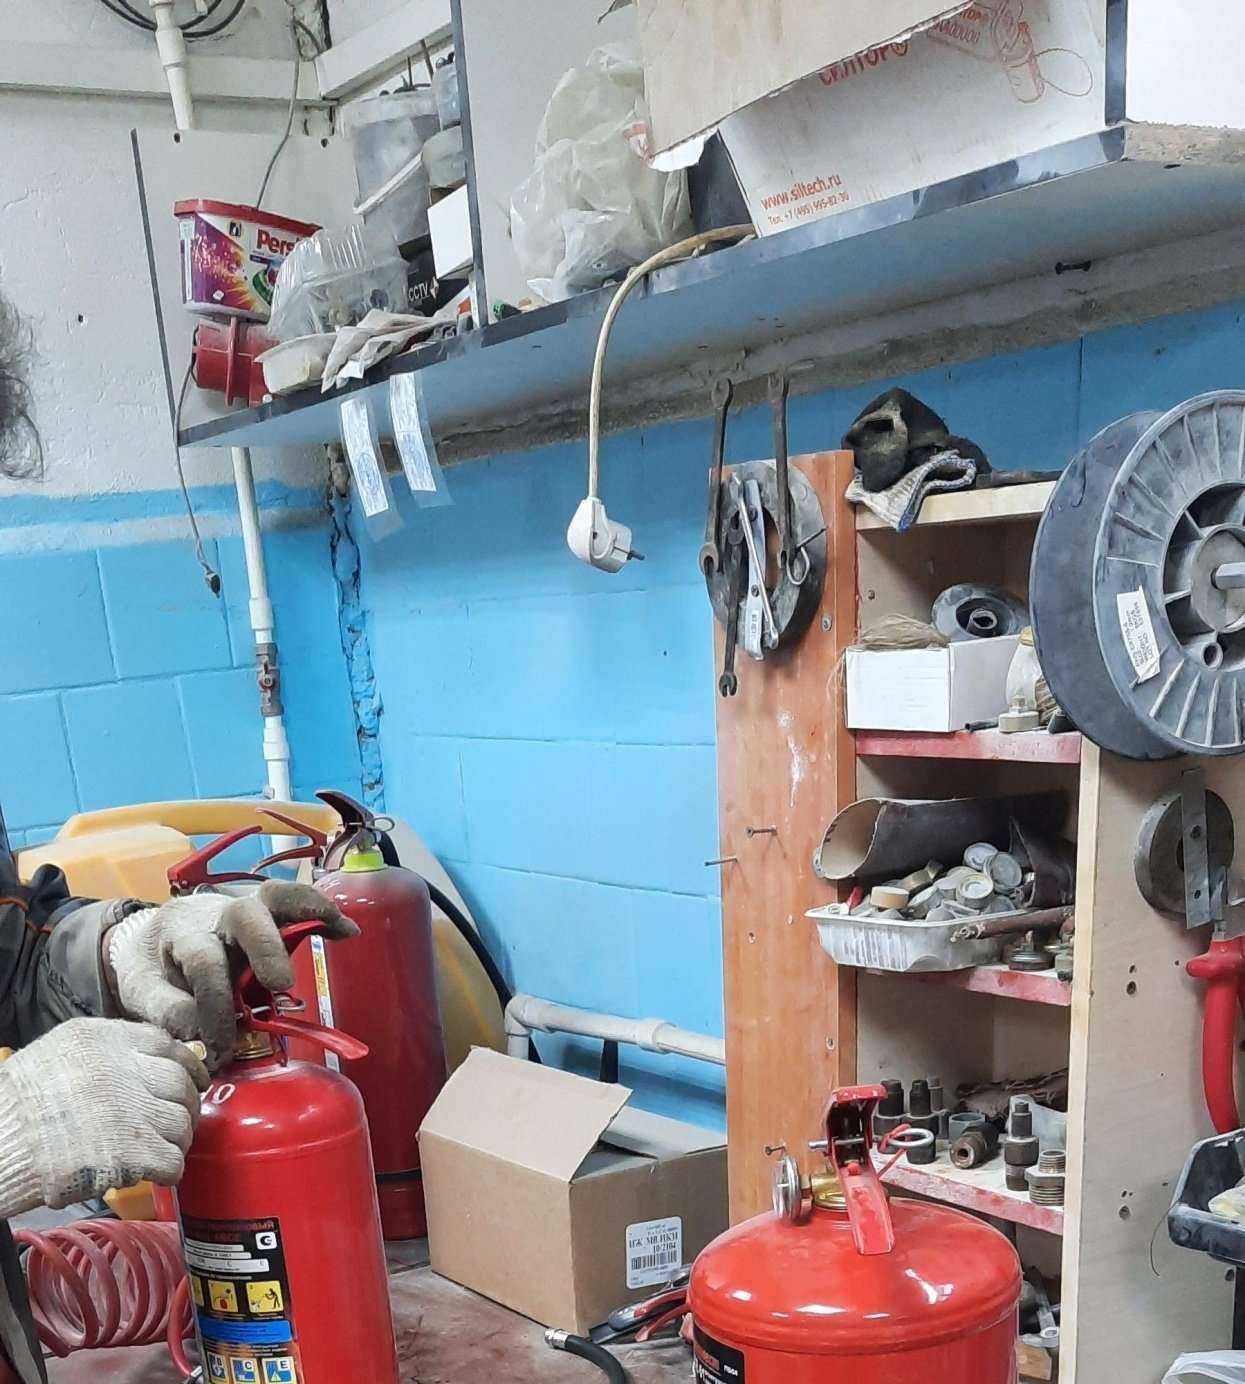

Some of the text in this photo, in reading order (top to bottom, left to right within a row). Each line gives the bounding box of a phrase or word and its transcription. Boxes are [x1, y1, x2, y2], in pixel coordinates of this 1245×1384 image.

[761, 174, 842, 209] www.siltech.ru
[257, 228, 300, 256] Pers
[408, 282, 429, 302] CCTV
